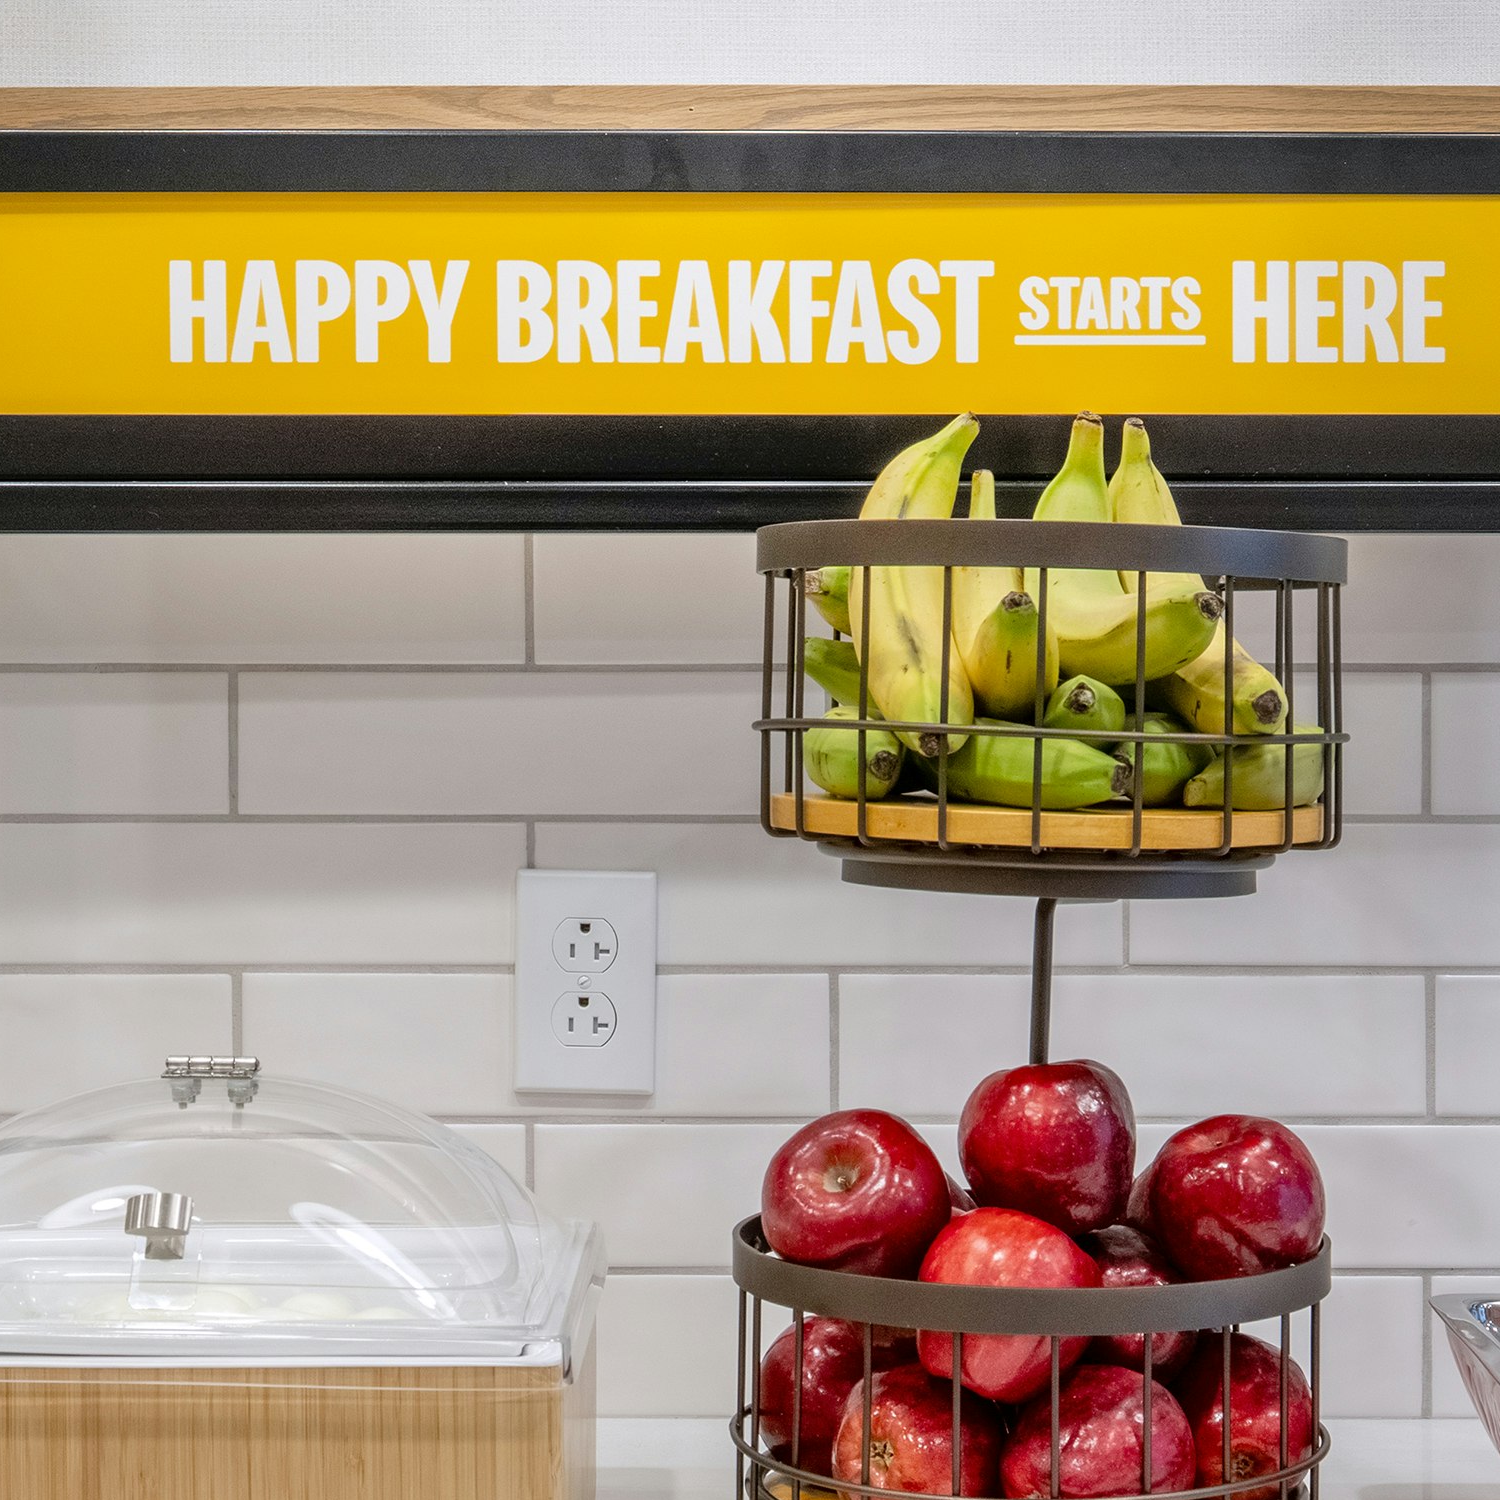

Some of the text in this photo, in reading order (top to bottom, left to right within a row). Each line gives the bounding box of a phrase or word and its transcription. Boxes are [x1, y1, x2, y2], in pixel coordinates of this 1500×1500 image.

[169, 258, 1446, 364] HAPPY BREAKFAST STARTS HERE
